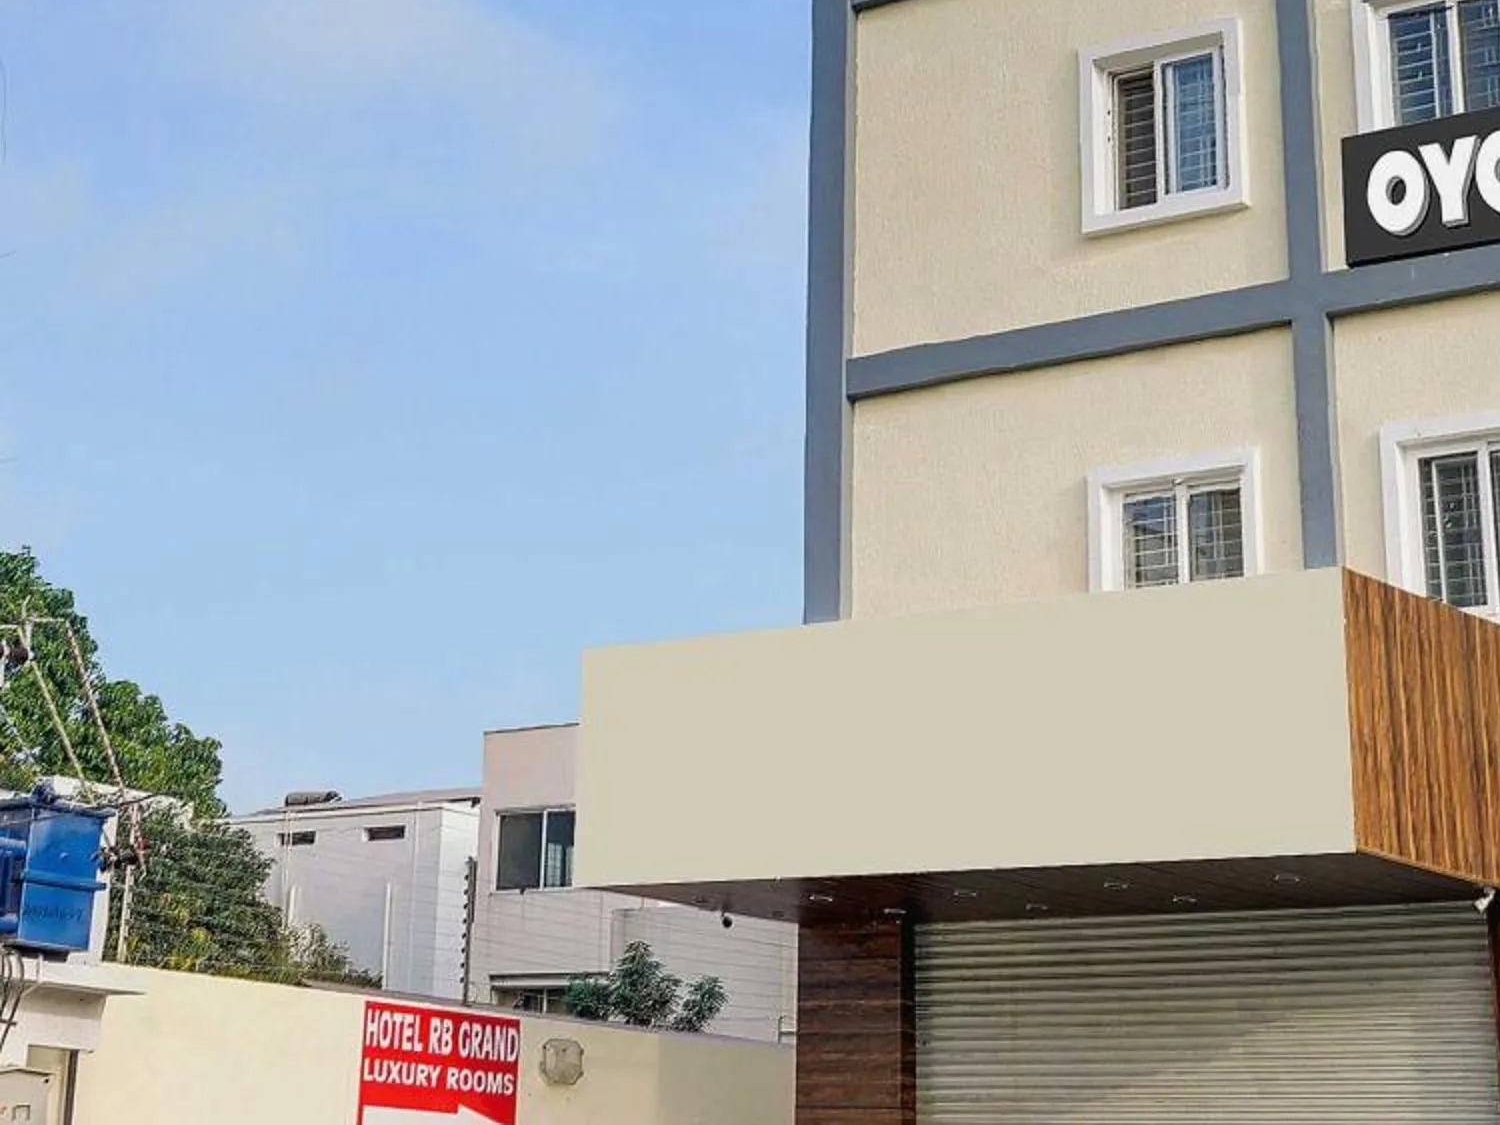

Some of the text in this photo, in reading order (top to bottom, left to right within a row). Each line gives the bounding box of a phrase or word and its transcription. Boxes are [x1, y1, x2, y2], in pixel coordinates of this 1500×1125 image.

[365, 1008, 520, 1062] HOTEL RB GRAND
[363, 1057, 515, 1095] LUXURY ROOMS
